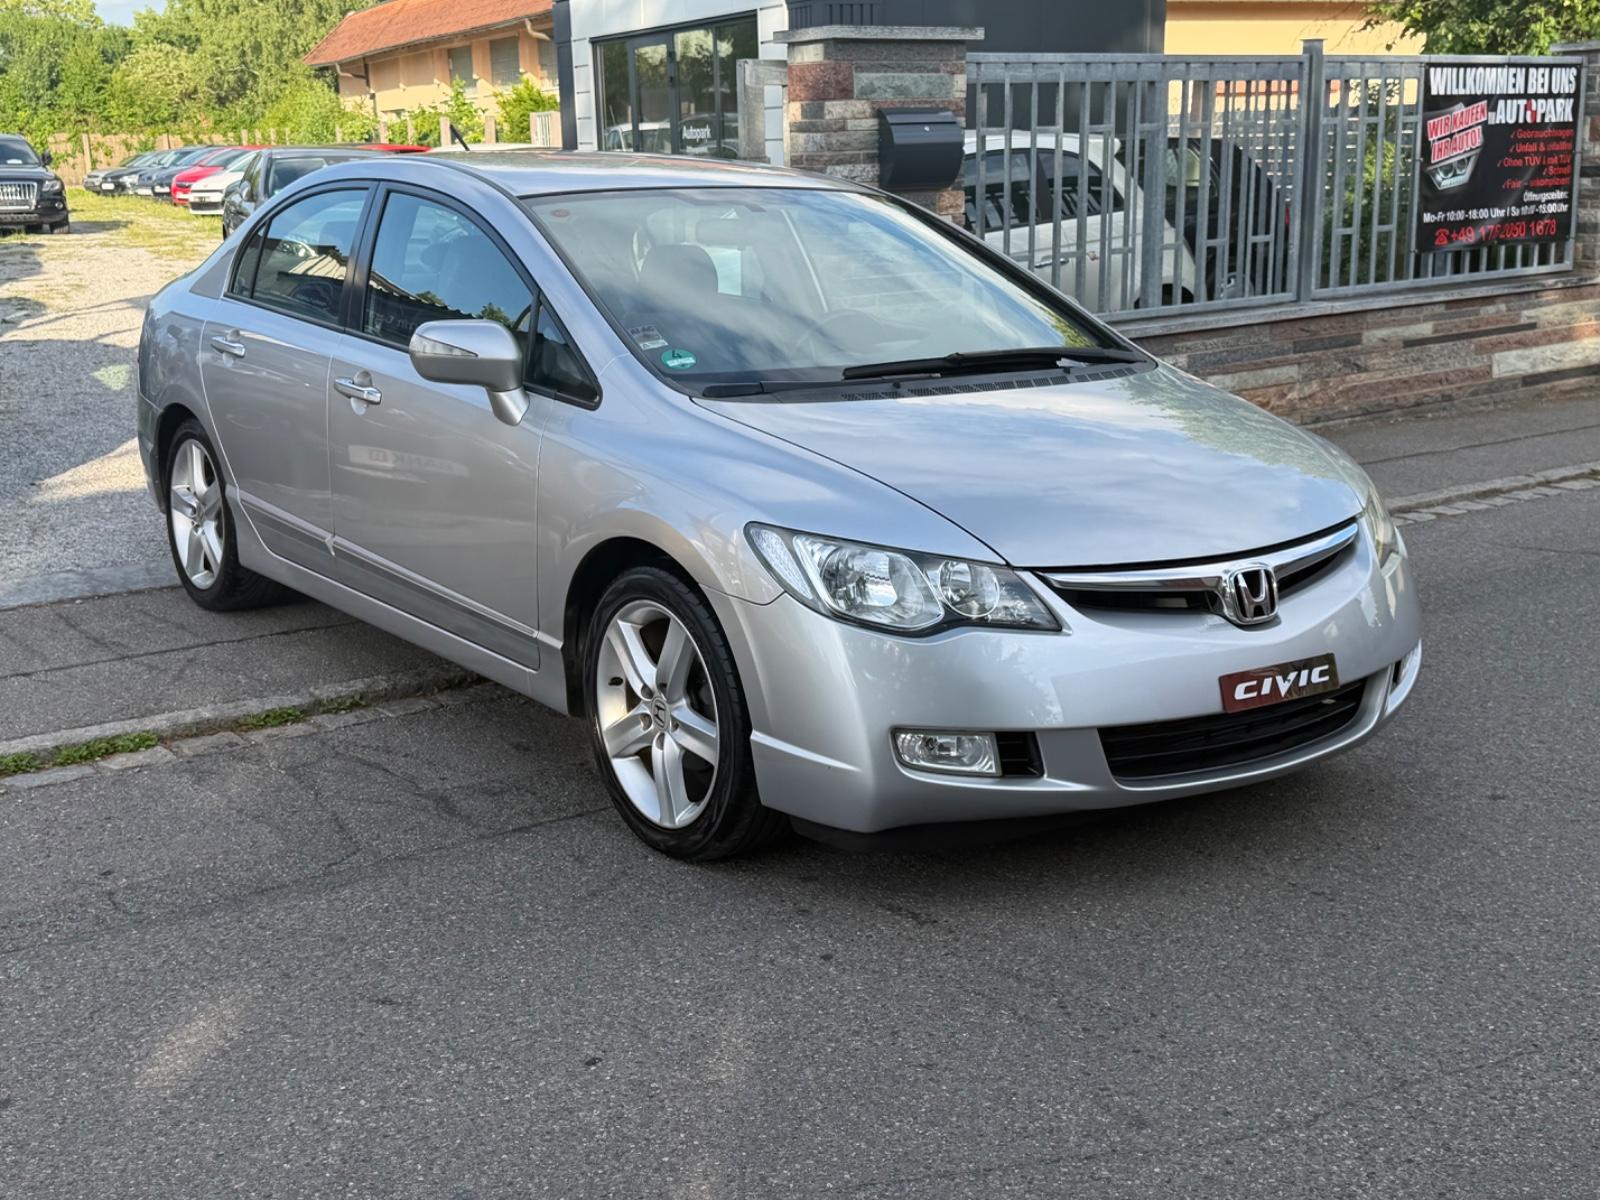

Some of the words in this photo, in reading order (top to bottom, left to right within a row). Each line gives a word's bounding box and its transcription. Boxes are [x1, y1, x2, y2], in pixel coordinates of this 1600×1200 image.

[1429, 67, 1526, 95] WILLKOMMEN
[1527, 67, 1549, 95] BEI
[1551, 67, 1577, 94] UNS
[682, 124, 712, 143] Autopark
[1427, 114, 1451, 140] WIR
[1451, 101, 1487, 132] KAUFEN
[1431, 139, 1451, 163] IHR
[1450, 126, 1483, 155] AUTO!
[1423, 211, 1445, 223] Mo-Fr
[1446, 209, 1465, 221] 10:00
[1490, 206, 1506, 218] Uhr
[1451, 225, 1475, 243] +49
[1233, 664, 1330, 700] CIVIC
